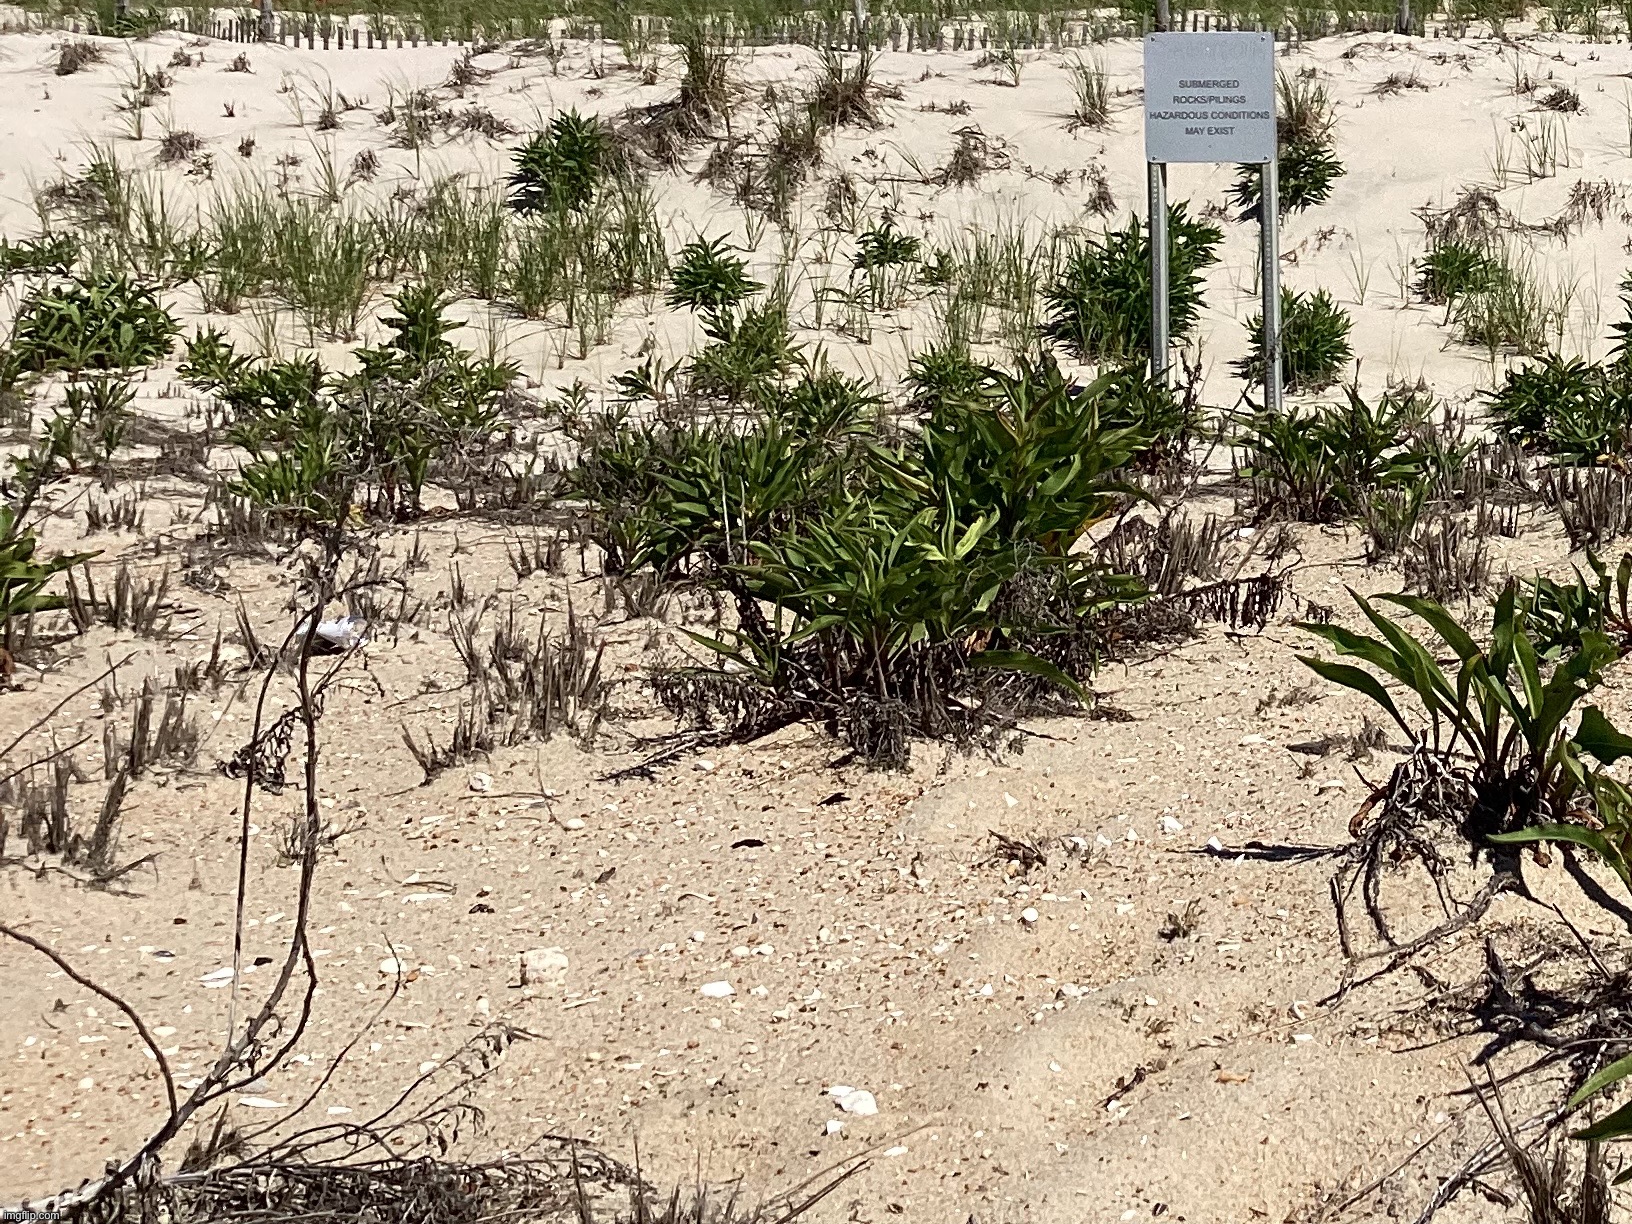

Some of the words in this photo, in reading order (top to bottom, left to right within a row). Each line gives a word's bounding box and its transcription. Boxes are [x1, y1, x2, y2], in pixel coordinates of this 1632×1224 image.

[1178, 79, 1239, 88] SUBMERGED
[1173, 95, 1246, 104] ROCKS/PILINGS
[1149, 111, 1208, 120] HAZARDOUS
[1210, 111, 1270, 120] CONDITIONS
[1185, 126, 1205, 135] MAY
[1207, 126, 1235, 135] EXIST
